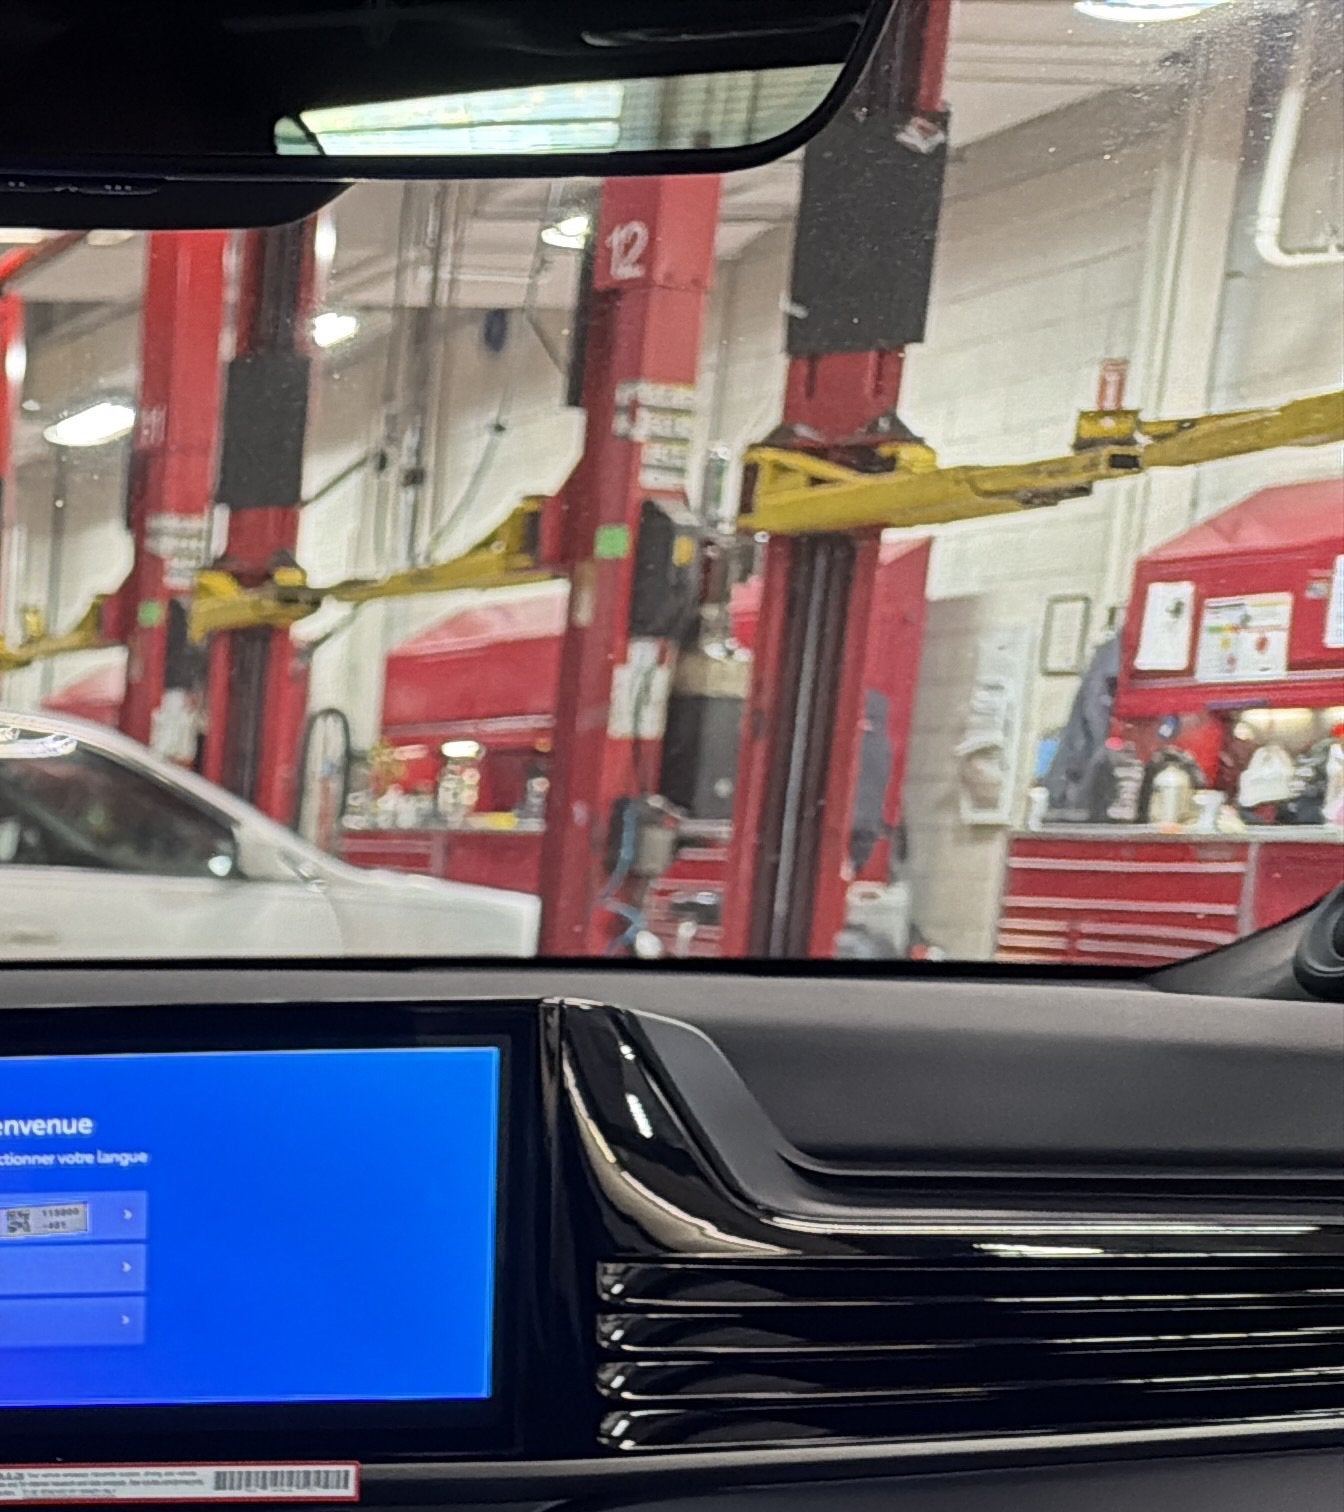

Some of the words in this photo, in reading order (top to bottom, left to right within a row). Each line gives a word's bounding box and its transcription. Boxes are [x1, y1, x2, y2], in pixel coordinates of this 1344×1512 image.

[605, 220, 649, 279] 12
[57, 1151, 94, 1166] votre
[96, 1149, 149, 1167] langue
